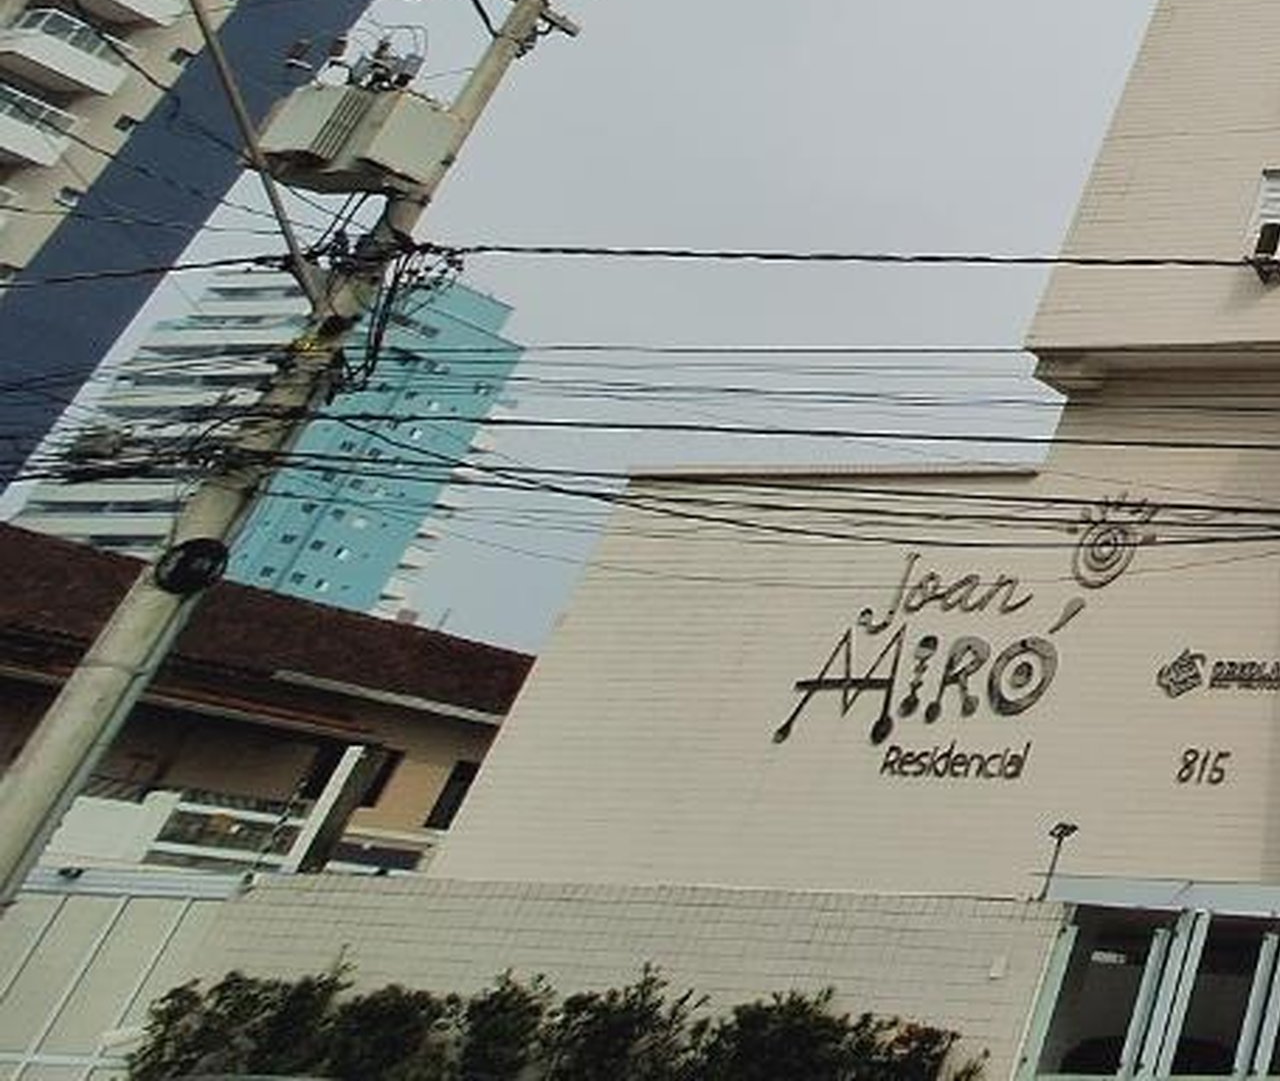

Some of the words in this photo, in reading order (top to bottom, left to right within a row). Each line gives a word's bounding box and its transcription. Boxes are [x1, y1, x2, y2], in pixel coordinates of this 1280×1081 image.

[857, 552, 1034, 635] Joan
[880, 739, 1033, 780] Residencial
[1177, 749, 1231, 786] 815
